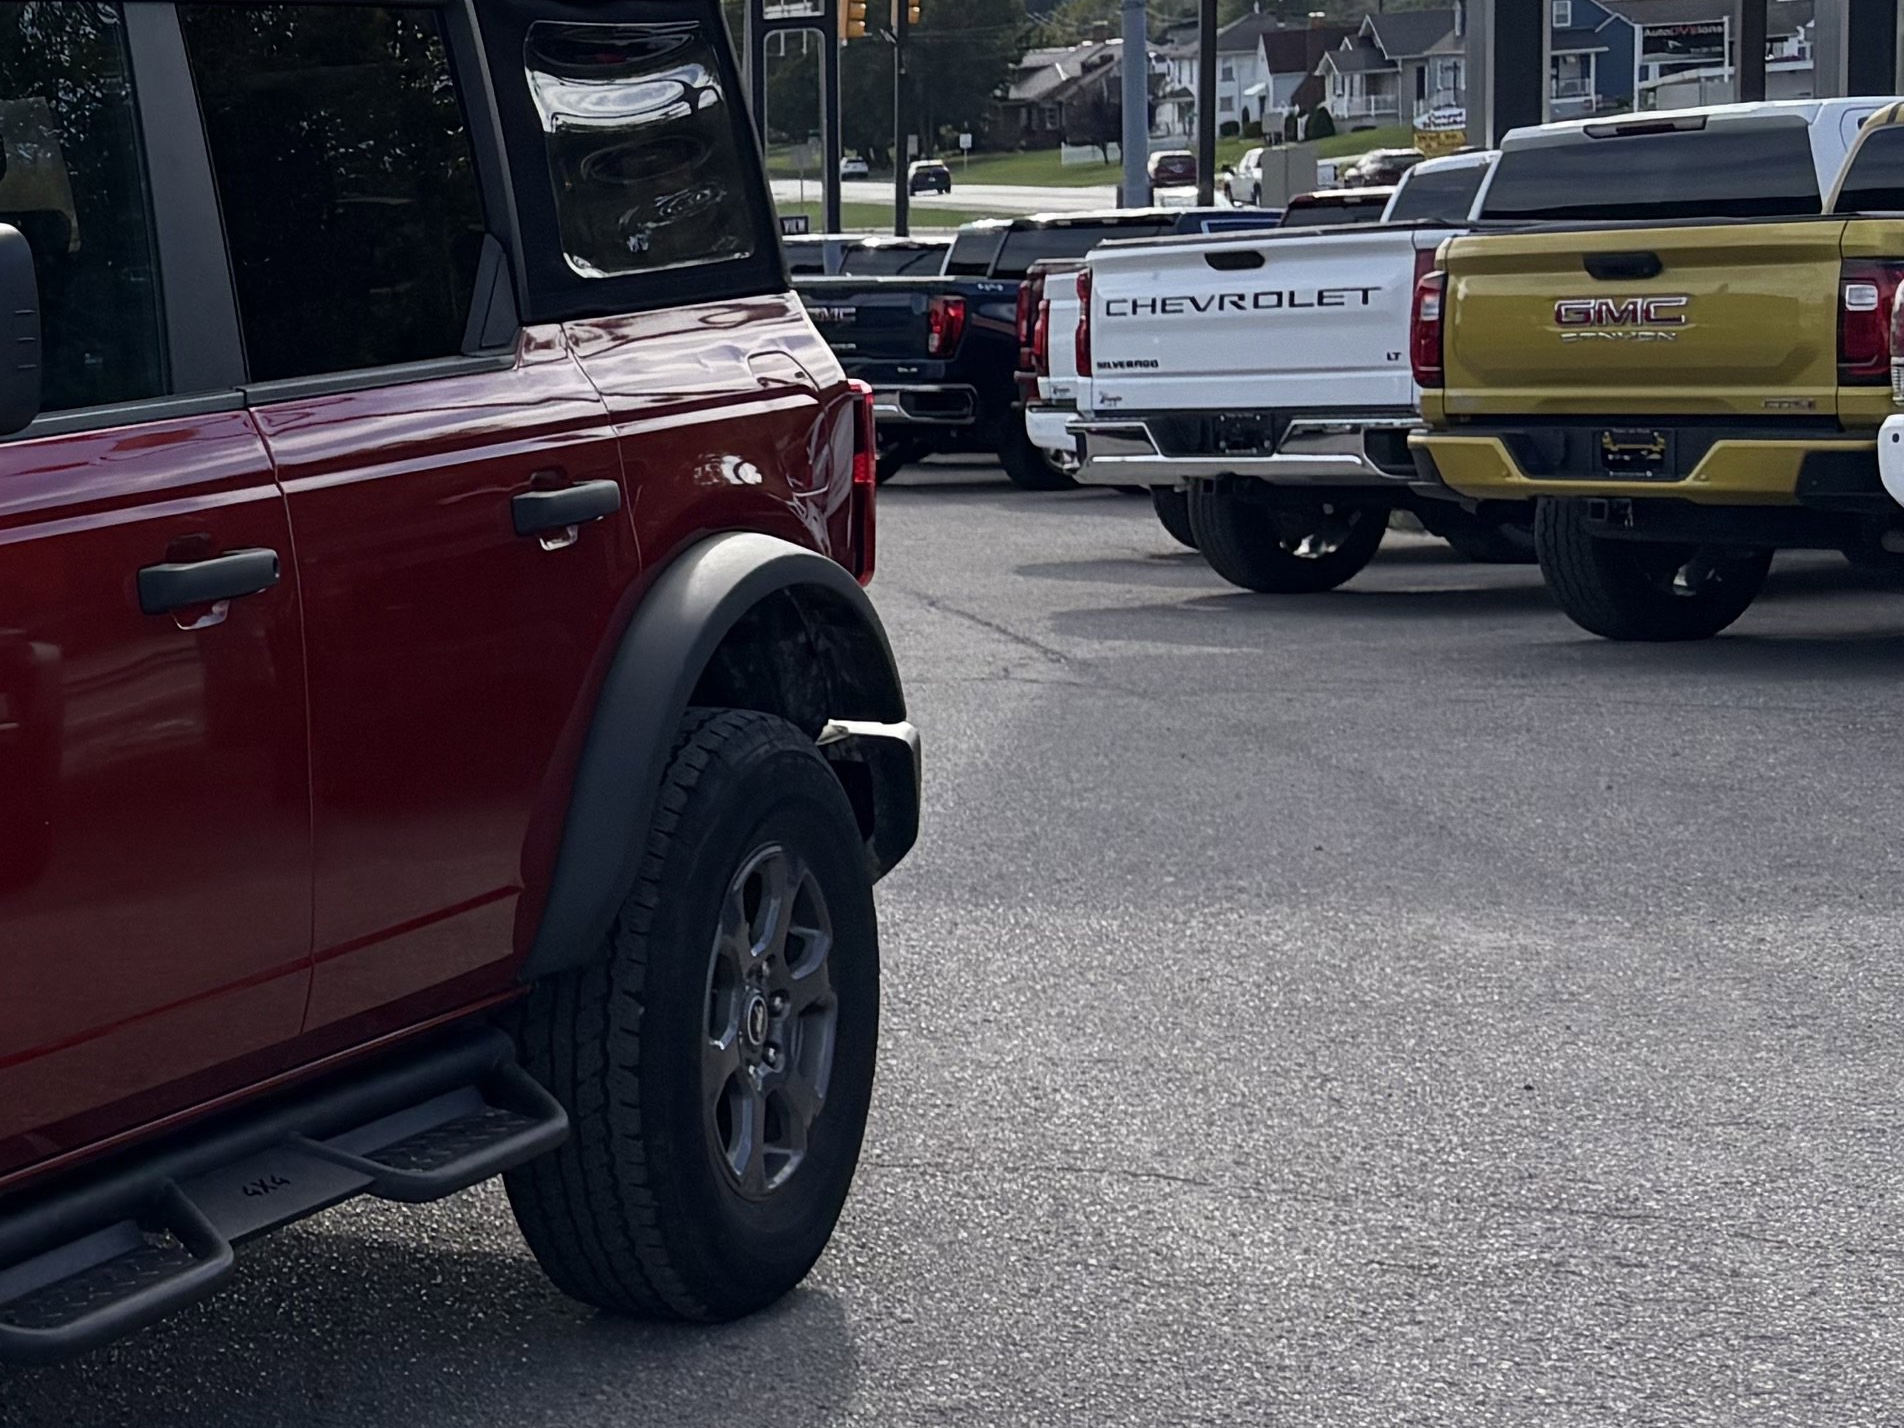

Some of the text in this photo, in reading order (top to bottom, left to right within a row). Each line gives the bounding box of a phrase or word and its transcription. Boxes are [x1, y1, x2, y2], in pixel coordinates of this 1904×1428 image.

[1105, 287, 1382, 317] CHEVROLET
[1555, 297, 1688, 327] GMC
[1386, 351, 1402, 361] LT
